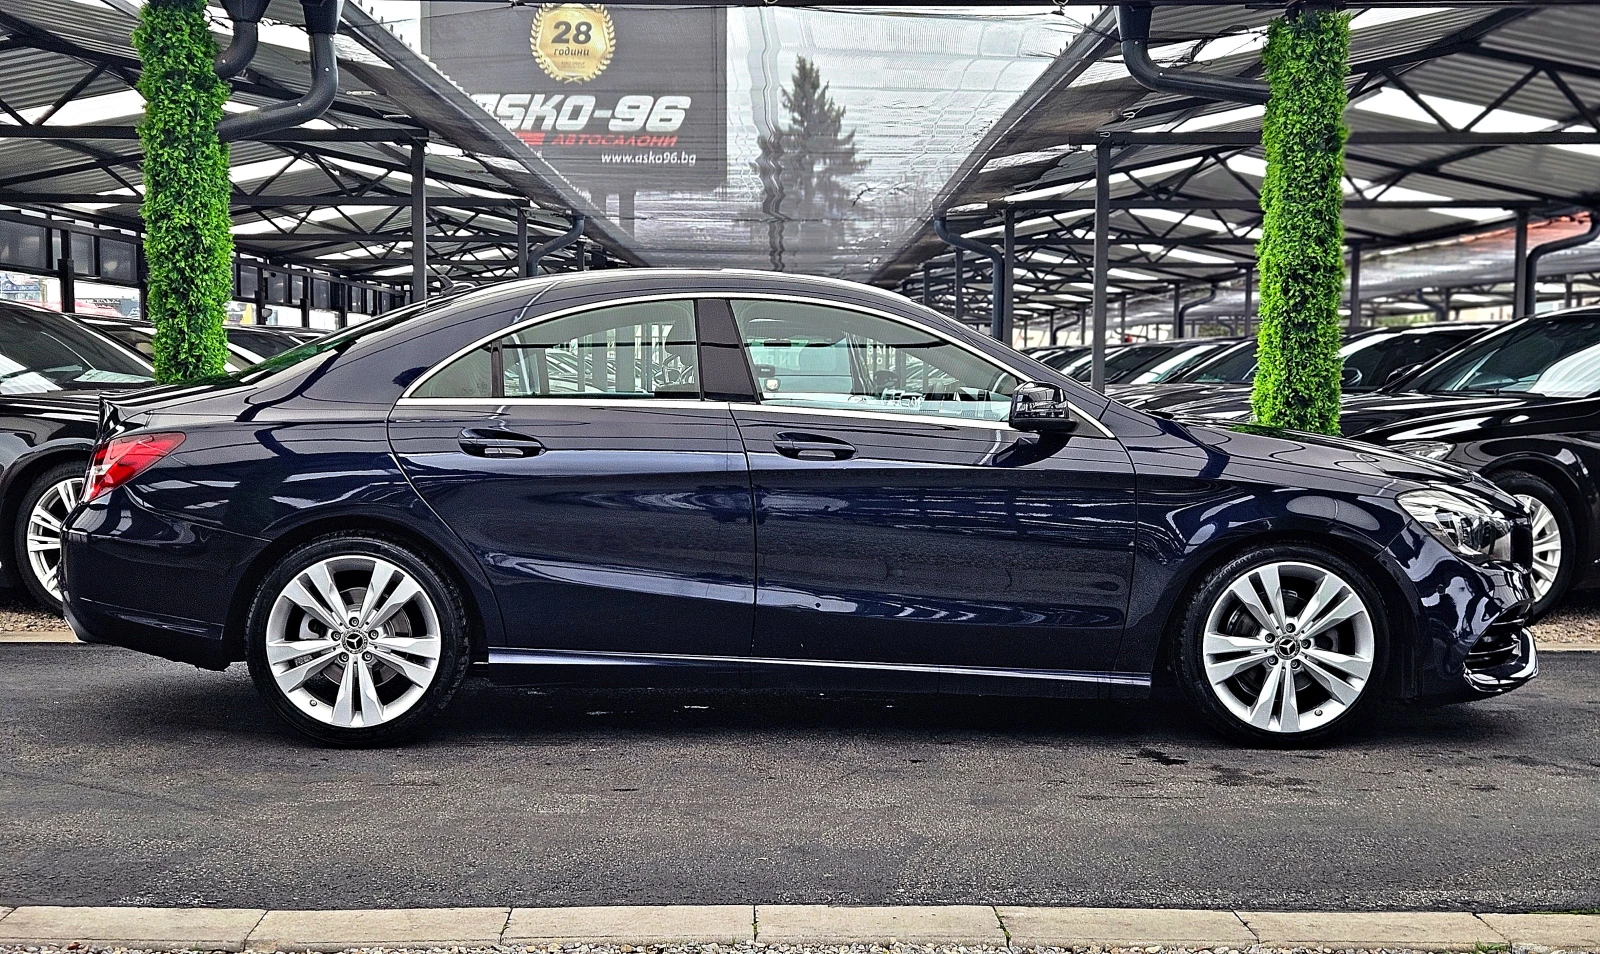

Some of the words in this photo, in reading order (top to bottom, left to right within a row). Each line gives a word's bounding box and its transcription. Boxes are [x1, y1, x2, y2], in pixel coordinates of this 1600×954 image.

[551, 20, 592, 44] 28
[553, 46, 590, 57] години
[551, 133, 679, 147] АВТОСАЛОНИ
[601, 150, 697, 167] www.asko96.bg
